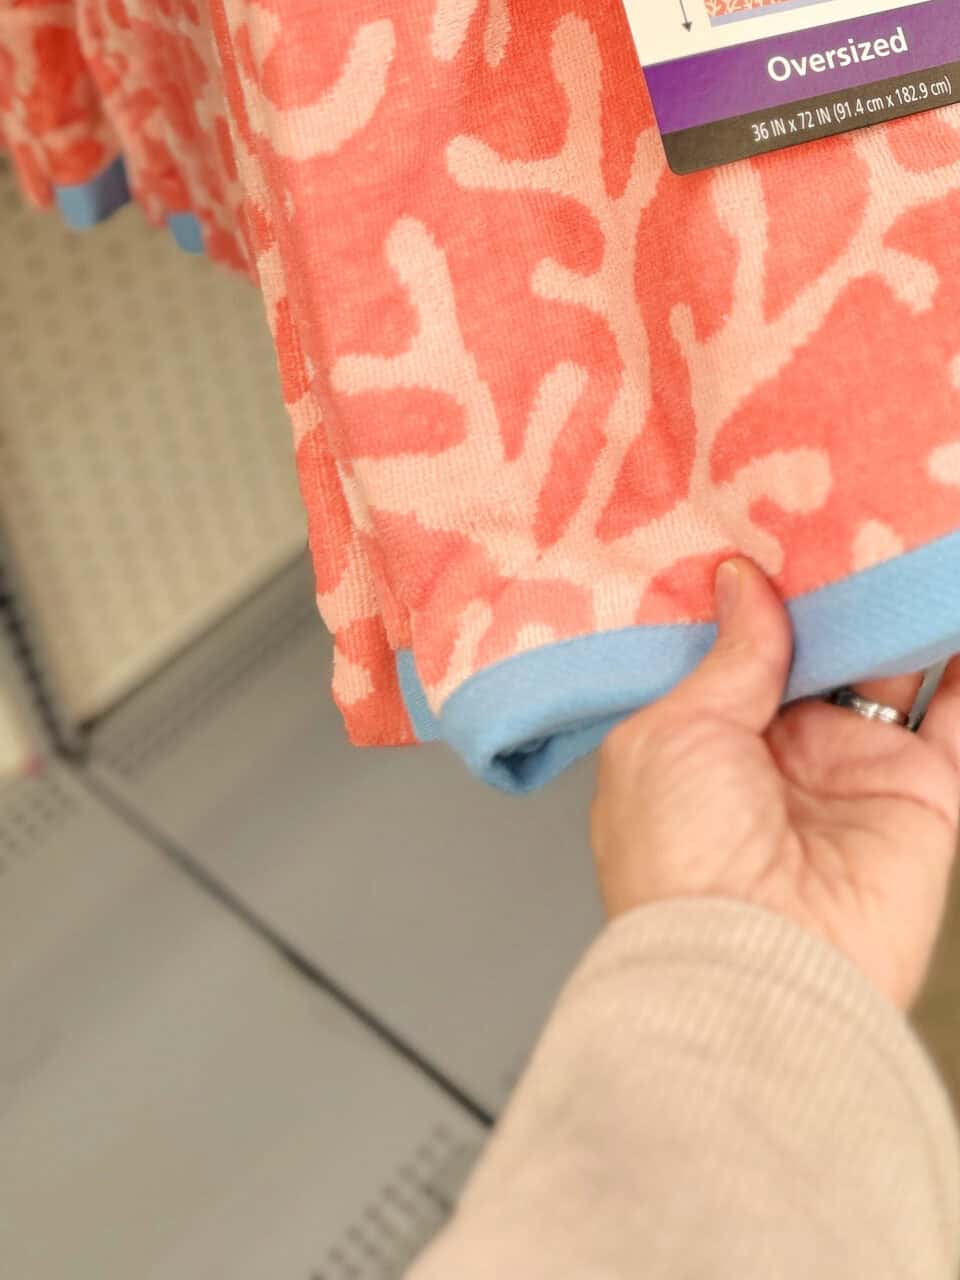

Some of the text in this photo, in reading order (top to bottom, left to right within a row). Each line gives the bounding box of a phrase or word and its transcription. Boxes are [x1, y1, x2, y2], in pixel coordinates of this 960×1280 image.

[766, 27, 909, 82] Oversized
[752, 74, 953, 141] 36 IN x 72 IN (91.4 cm x 182.9 cm)
